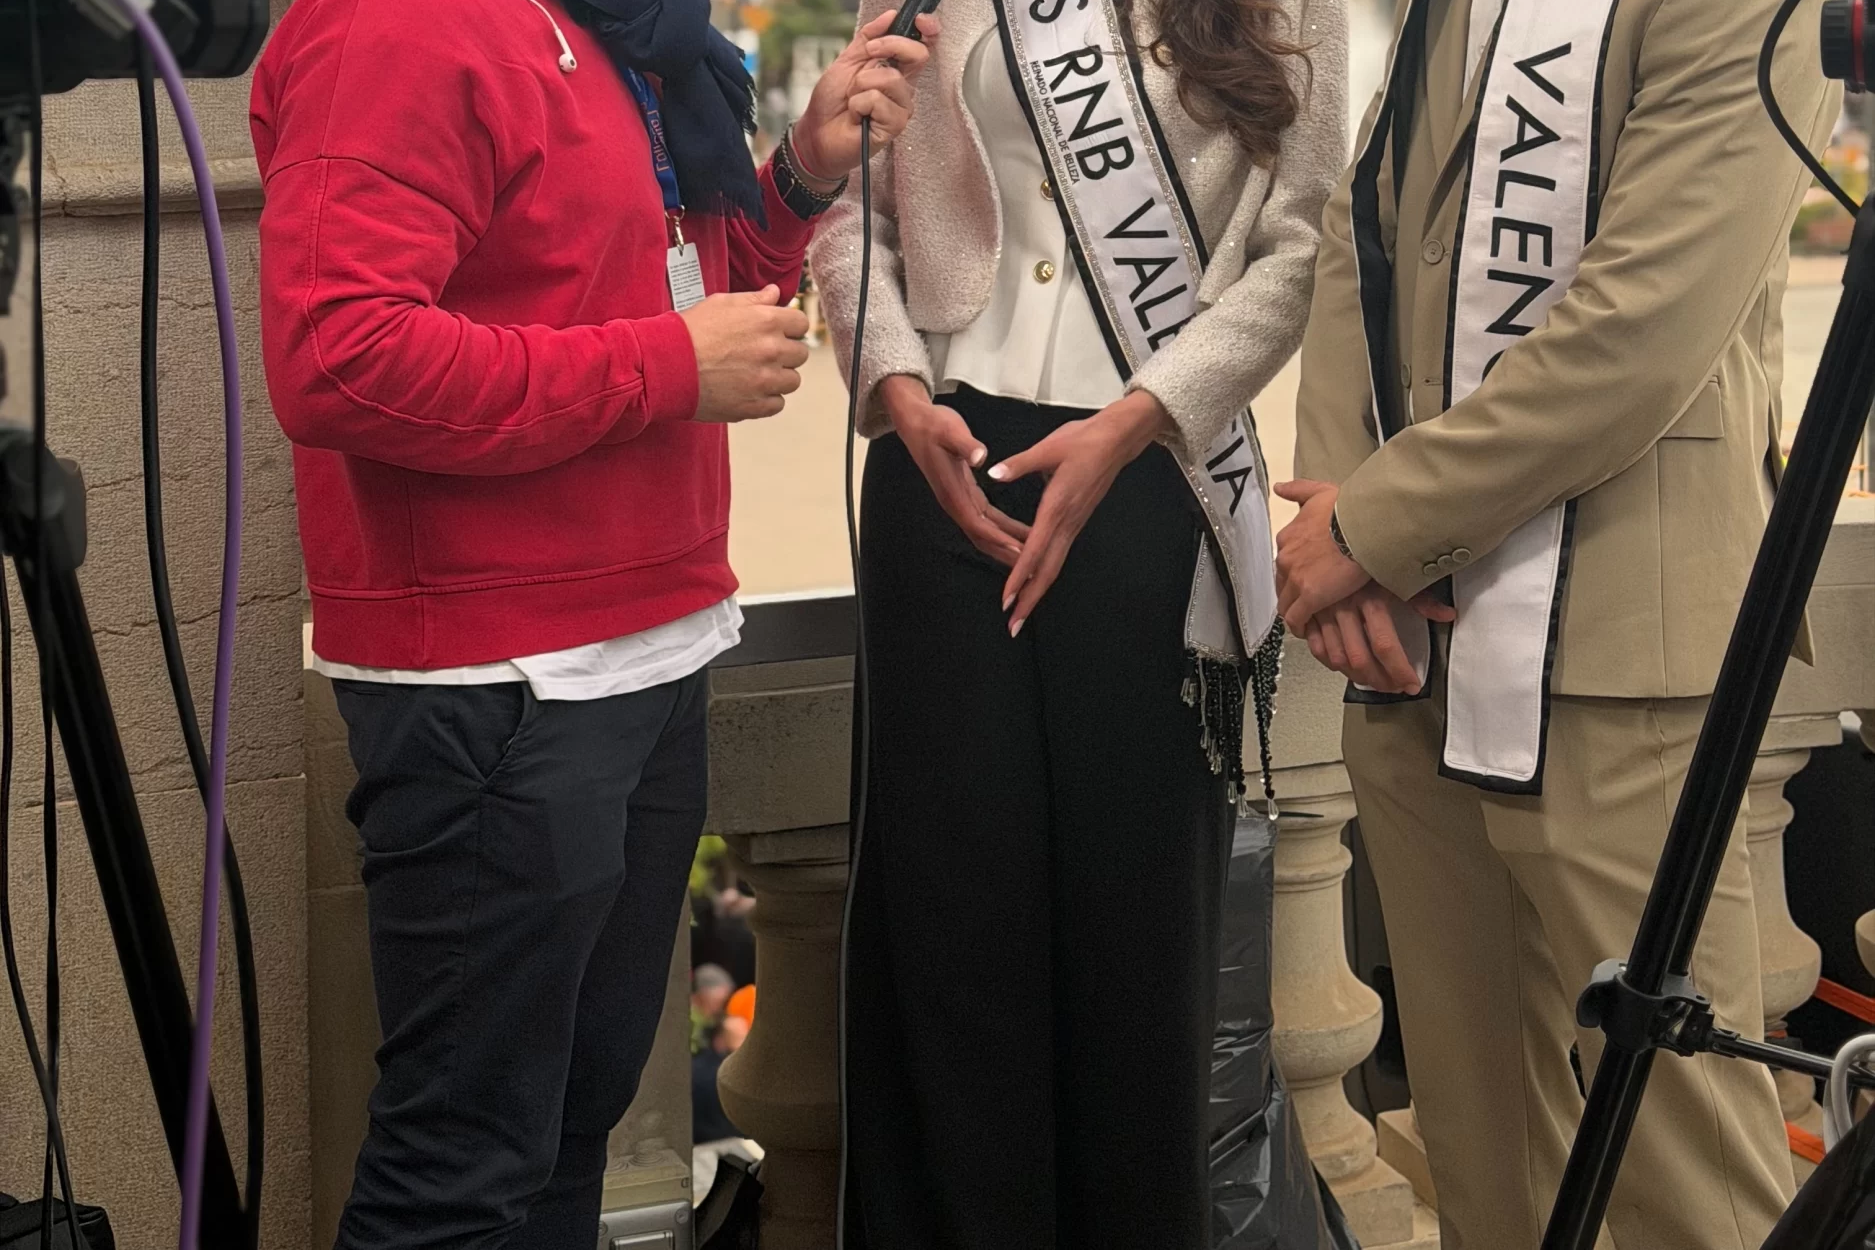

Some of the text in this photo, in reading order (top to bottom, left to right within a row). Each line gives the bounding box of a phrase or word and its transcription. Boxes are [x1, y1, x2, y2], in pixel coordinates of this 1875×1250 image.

[1030, 60, 1081, 186] REINADO NACIONAL DE BELLEZA
[1043, 44, 1135, 181] RNB
[1482, 41, 1573, 385] VALEN
